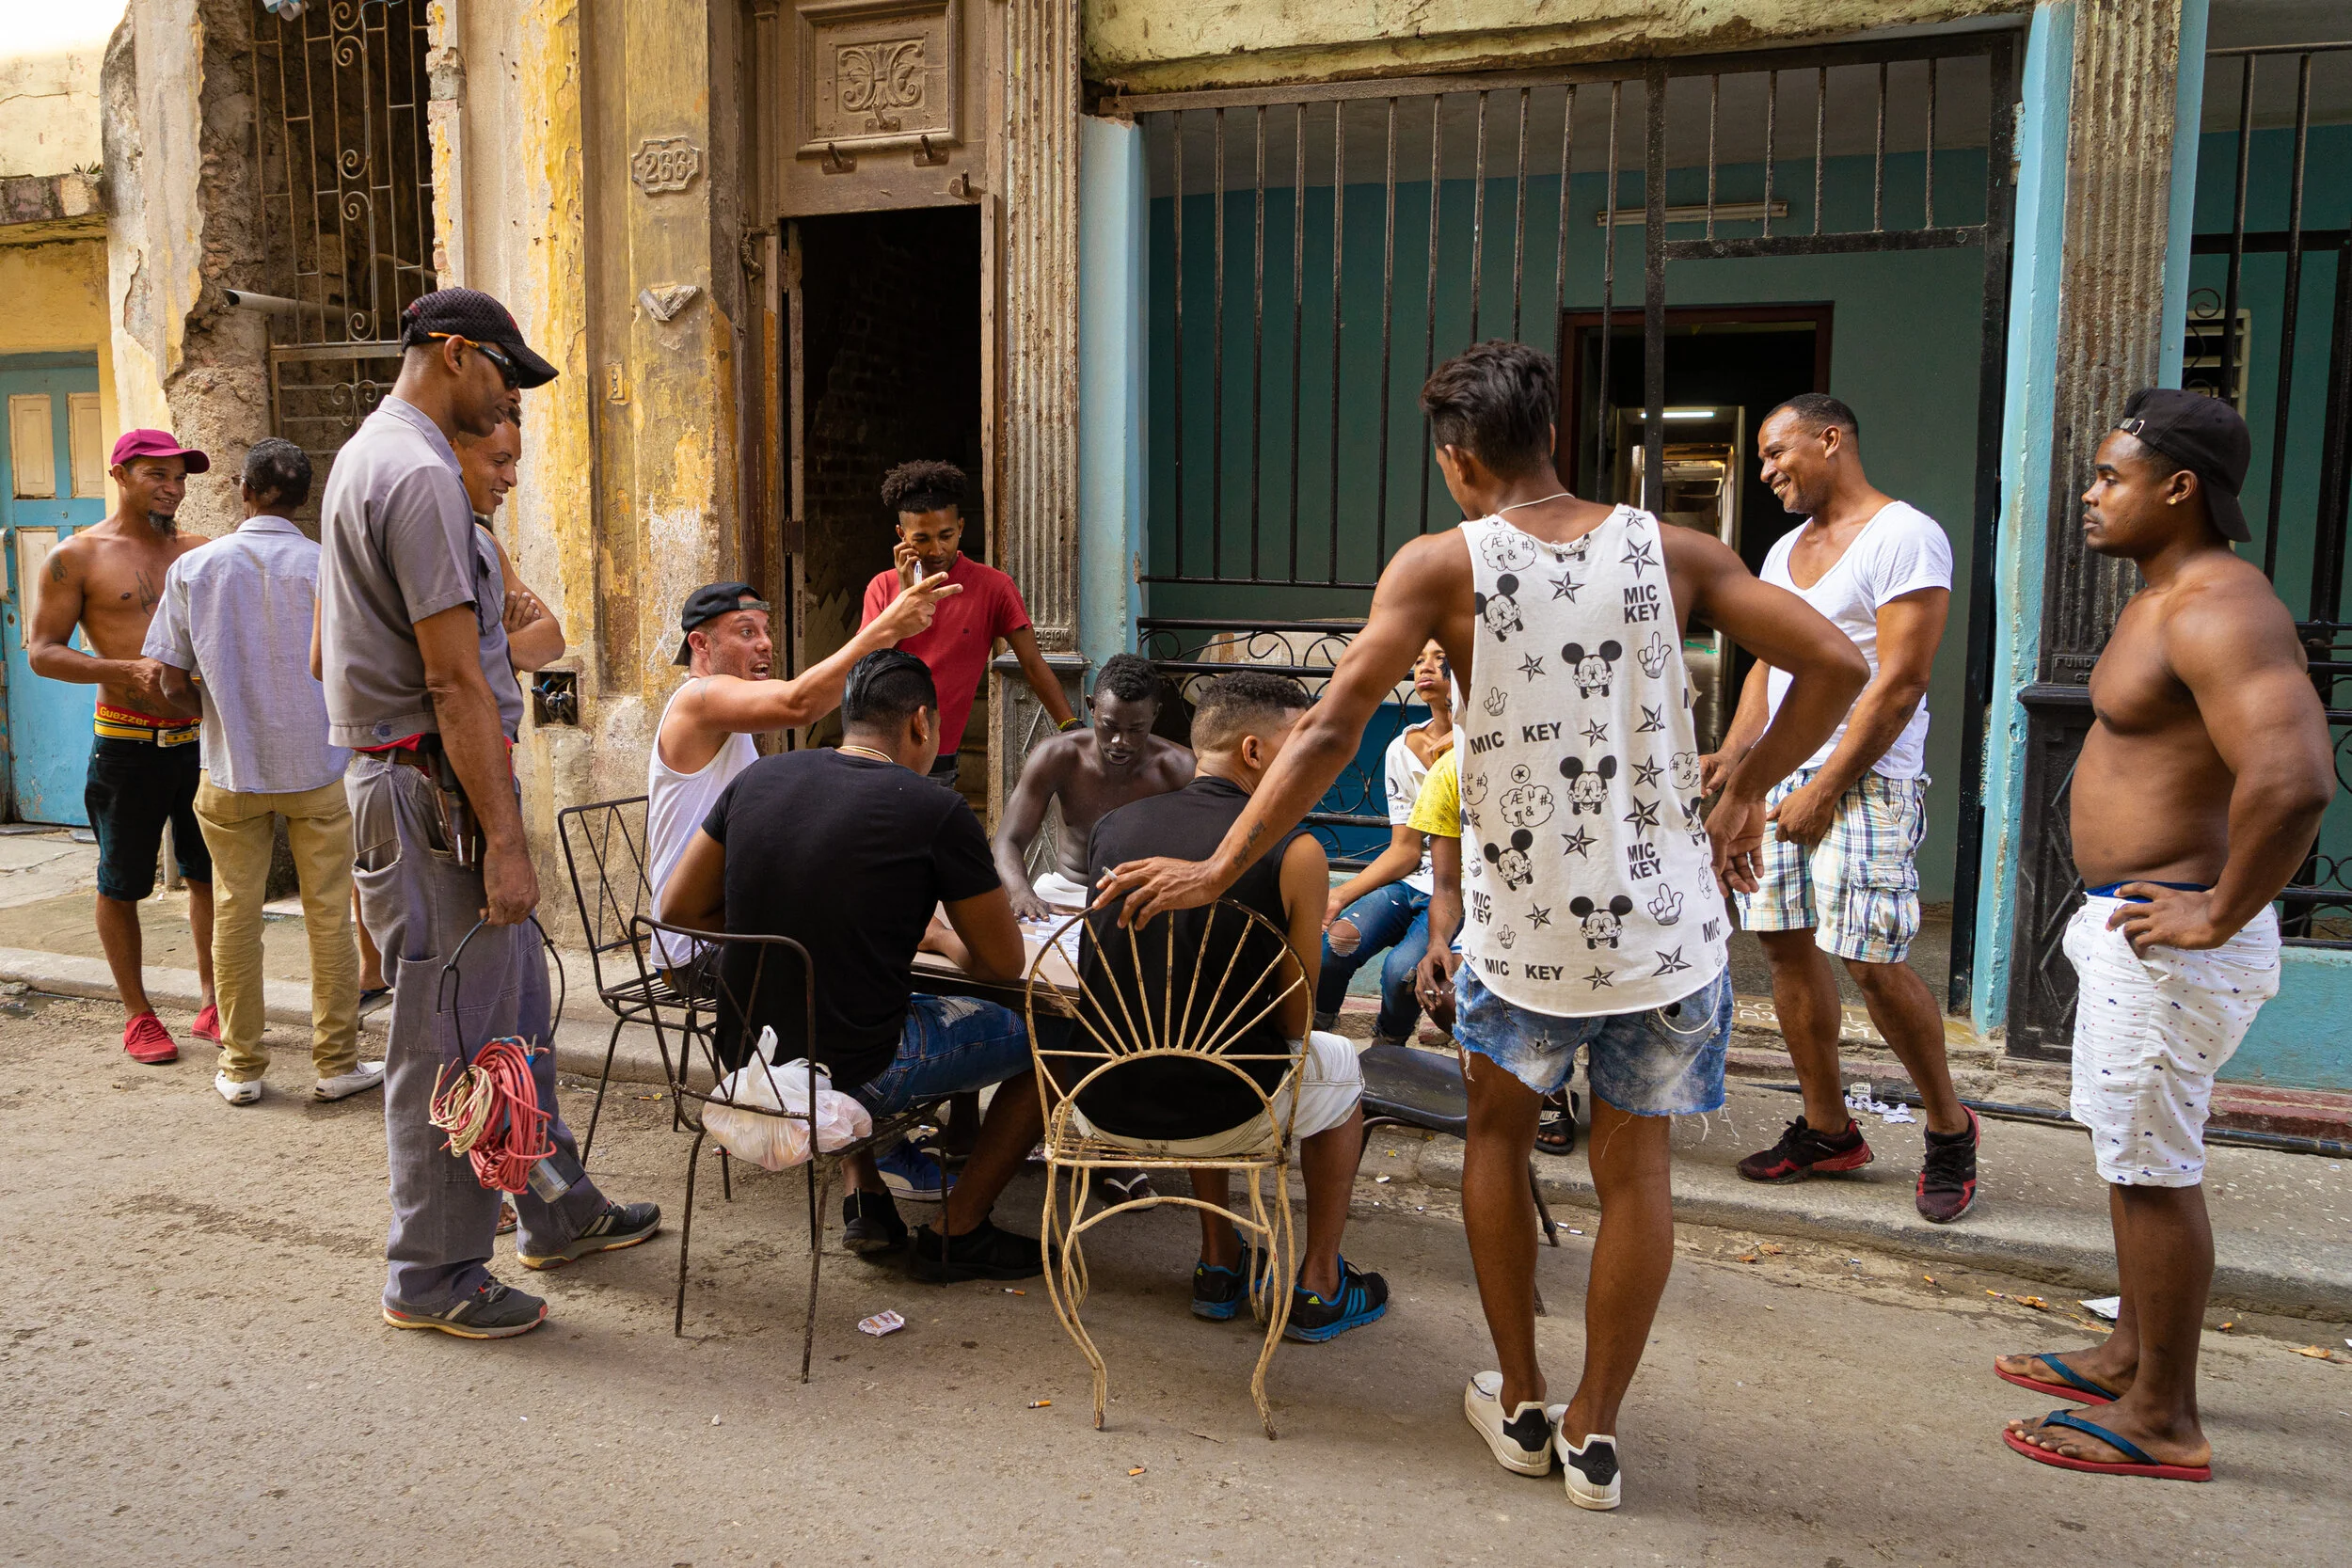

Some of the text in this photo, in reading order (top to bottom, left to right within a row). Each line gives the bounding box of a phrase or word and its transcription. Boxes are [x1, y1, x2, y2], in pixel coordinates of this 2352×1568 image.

[644, 150, 688, 182] 266
[1623, 584, 1658, 605] MIC
[1623, 603, 1661, 625] KEY
[1470, 721, 1562, 755] MIC KEY
[1627, 842, 1656, 863] MIC
[1629, 858, 1661, 881] KEY
[1702, 916, 1721, 943] MIC
[1485, 958, 1565, 981] MIC KEY
